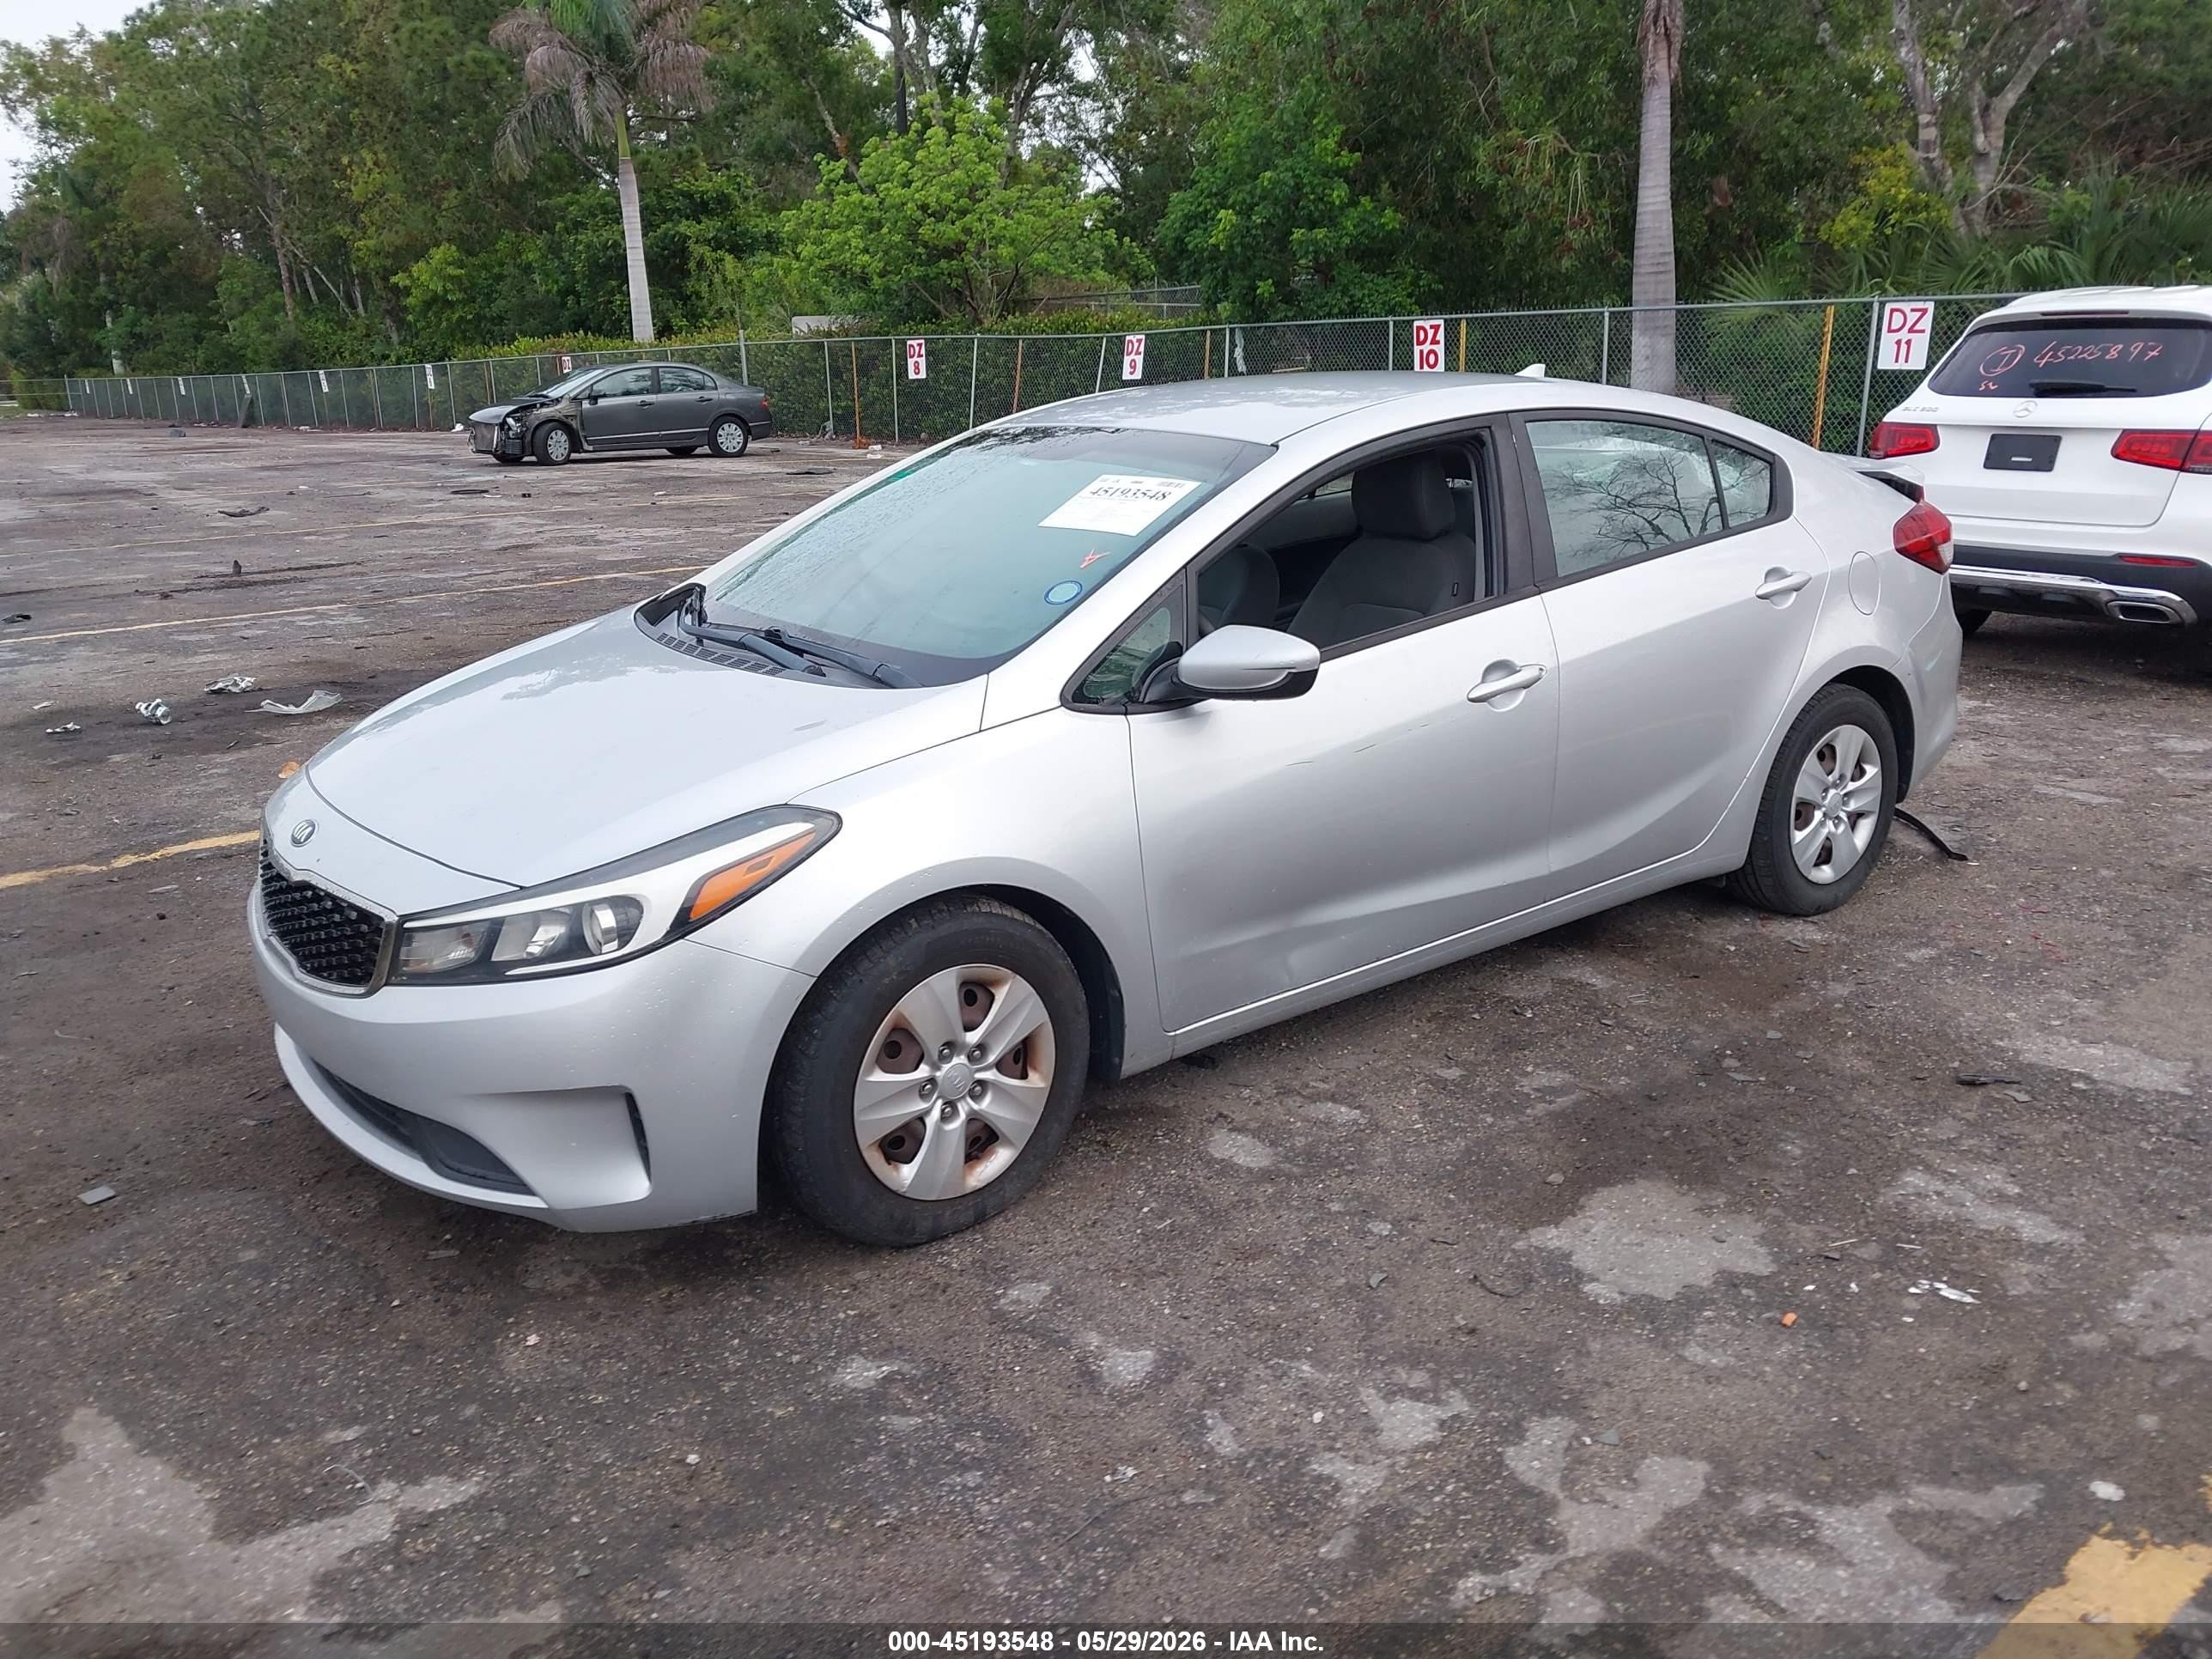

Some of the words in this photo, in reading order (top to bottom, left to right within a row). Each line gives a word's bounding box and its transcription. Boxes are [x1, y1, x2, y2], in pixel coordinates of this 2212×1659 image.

[1887, 307, 1929, 333] DZ
[1415, 324, 1442, 346] DZ
[908, 343, 924, 359] DZ
[1126, 338, 1143, 356] DZ
[1894, 338, 1912, 363] 11
[914, 361, 921, 375] 8
[1129, 358, 1137, 375] 9
[1419, 348, 1439, 370] 10
[1089, 486, 1172, 501] 45193548
